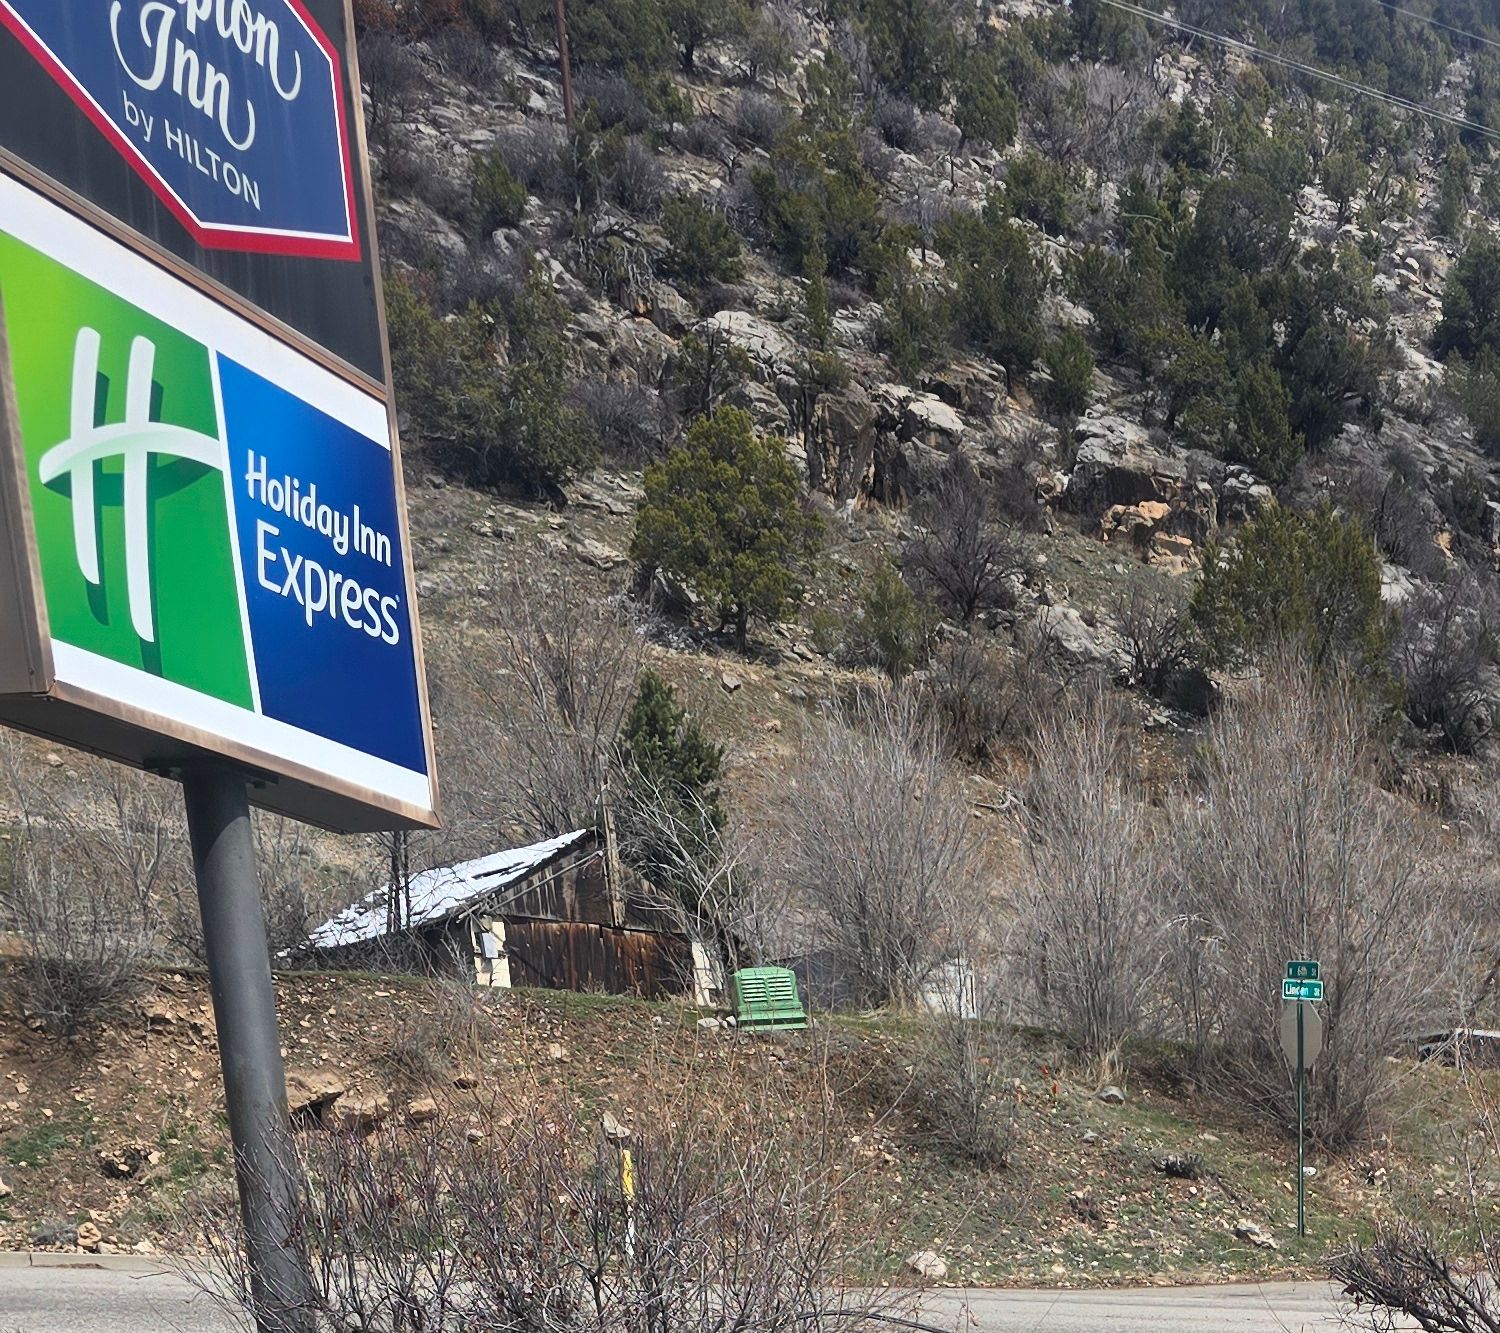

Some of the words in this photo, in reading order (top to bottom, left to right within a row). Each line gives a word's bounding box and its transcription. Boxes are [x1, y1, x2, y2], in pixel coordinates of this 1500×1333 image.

[110, 1, 256, 151] Inn
[177, 0, 302, 101] pton
[122, 89, 154, 143] by
[164, 118, 261, 212] HILTON
[245, 448, 349, 556] Holiday
[353, 503, 392, 568] Inn
[256, 518, 400, 646] Express
